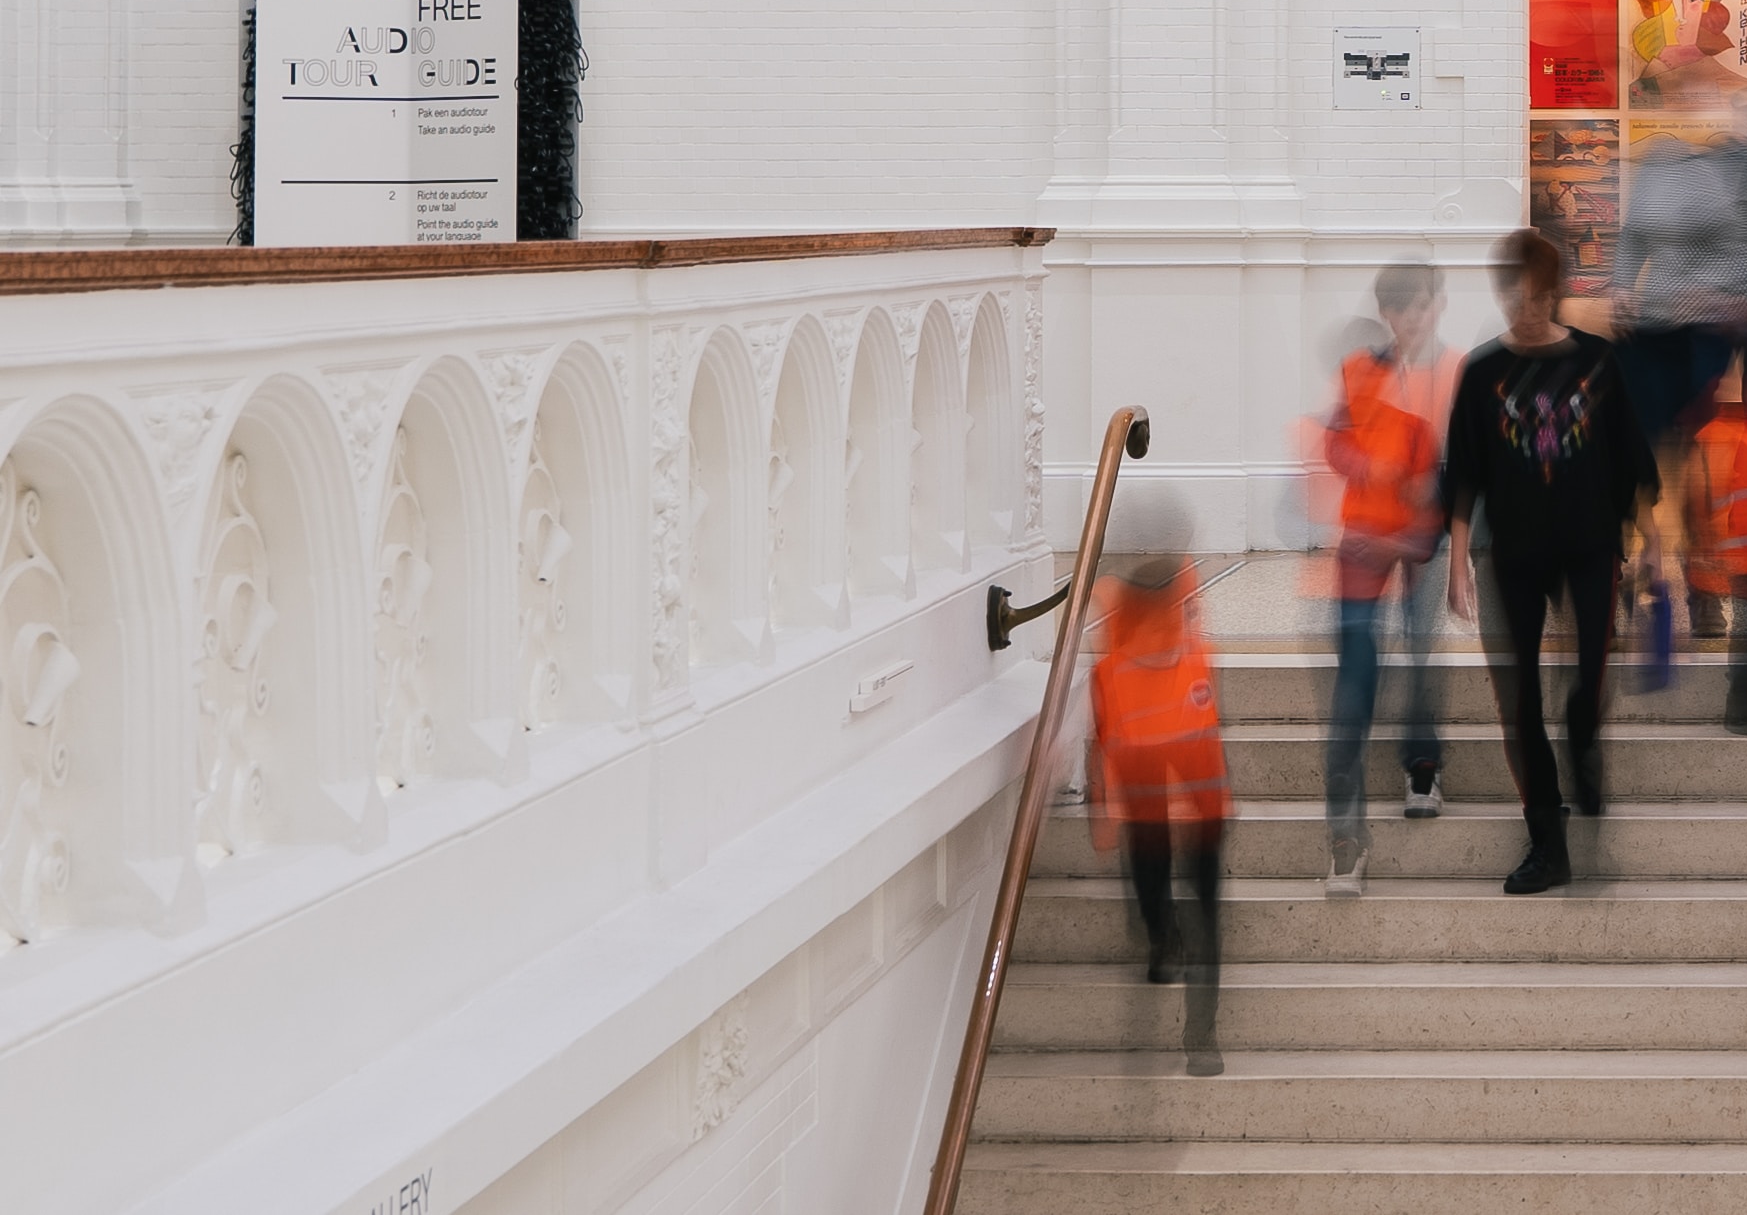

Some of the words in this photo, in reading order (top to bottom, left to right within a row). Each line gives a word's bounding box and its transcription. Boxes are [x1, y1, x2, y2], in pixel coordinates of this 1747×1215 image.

[336, 26, 436, 54] AUDIO
[282, 58, 379, 87] TOUR
[417, 58, 497, 88] GUIDE
[392, 109, 396, 118] 1
[417, 108, 433, 119] Pak
[434, 109, 449, 118] een
[450, 107, 489, 118] audiotour
[417, 124, 436, 135] Take
[437, 126, 448, 135] an
[449, 124, 471, 135] audio
[473, 124, 496, 136] guide
[388, 190, 396, 201] 2
[417, 190, 438, 200] Richt
[438, 190, 449, 200] de
[450, 189, 489, 200] audiotour
[417, 204, 427, 214] op
[428, 204, 441, 213] uw
[441, 203, 457, 212] taal
[416, 219, 437, 230] Point
[438, 219, 451, 230] the
[452, 219, 474, 230] audio
[475, 219, 499, 231] guide
